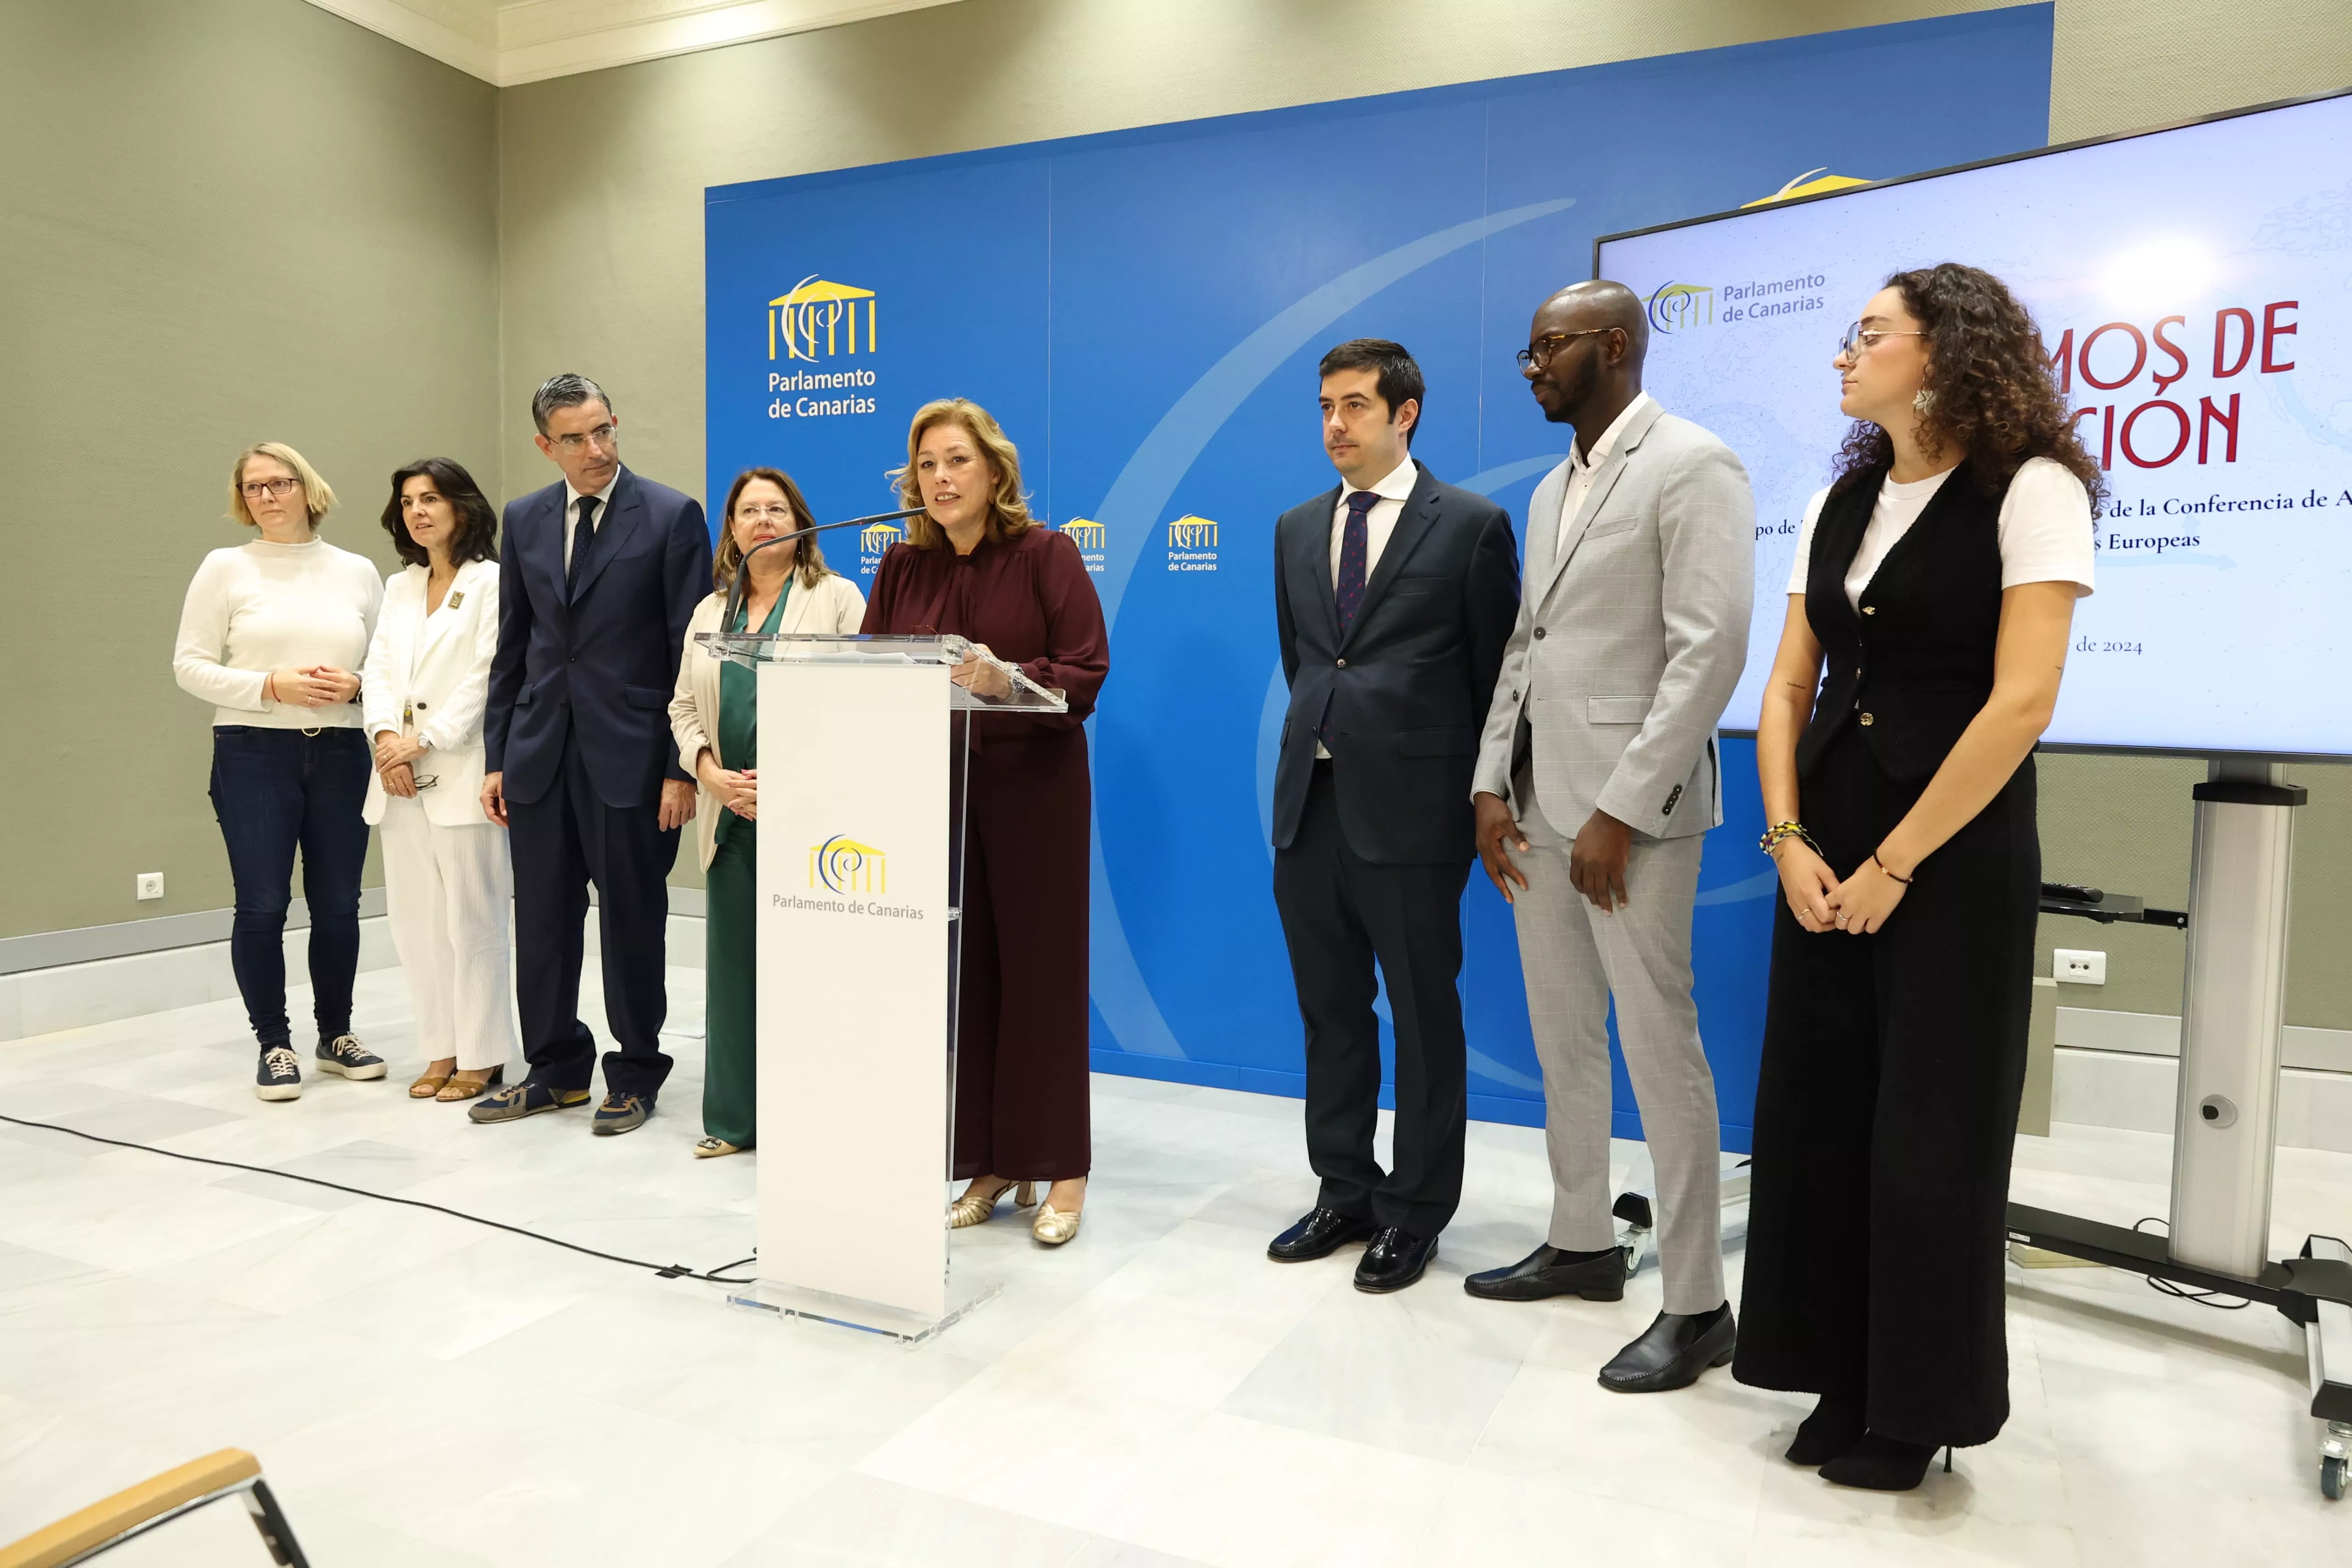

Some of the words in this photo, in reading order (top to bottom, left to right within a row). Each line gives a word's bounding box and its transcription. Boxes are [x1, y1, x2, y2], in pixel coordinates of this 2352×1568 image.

[1724, 275, 1825, 301] Parlamento
[1722, 306, 1744, 323] de
[1748, 294, 1824, 318] Canarias
[2049, 315, 2189, 394] MOS
[2212, 300, 2299, 378] DE
[769, 368, 876, 392] Parlamento
[768, 398, 792, 419] de
[796, 394, 876, 417] Canarias
[2109, 500, 2132, 517] de
[2139, 498, 2156, 516] la
[2163, 494, 2294, 515] Conferencia
[2301, 488, 2328, 508] de
[1778, 519, 1795, 534] de
[2109, 533, 2200, 554] Europeas
[1168, 551, 1217, 560] Parlamento
[1168, 562, 1179, 571] de
[1180, 562, 1217, 571] Canarias
[861, 566, 870, 574] de
[1085, 563, 1104, 572] arias
[2076, 635, 2097, 652] de
[2103, 641, 2143, 656] 2024
[773, 894, 845, 912] Parlamento
[848, 900, 864, 914] de
[867, 902, 923, 919] Canarias
